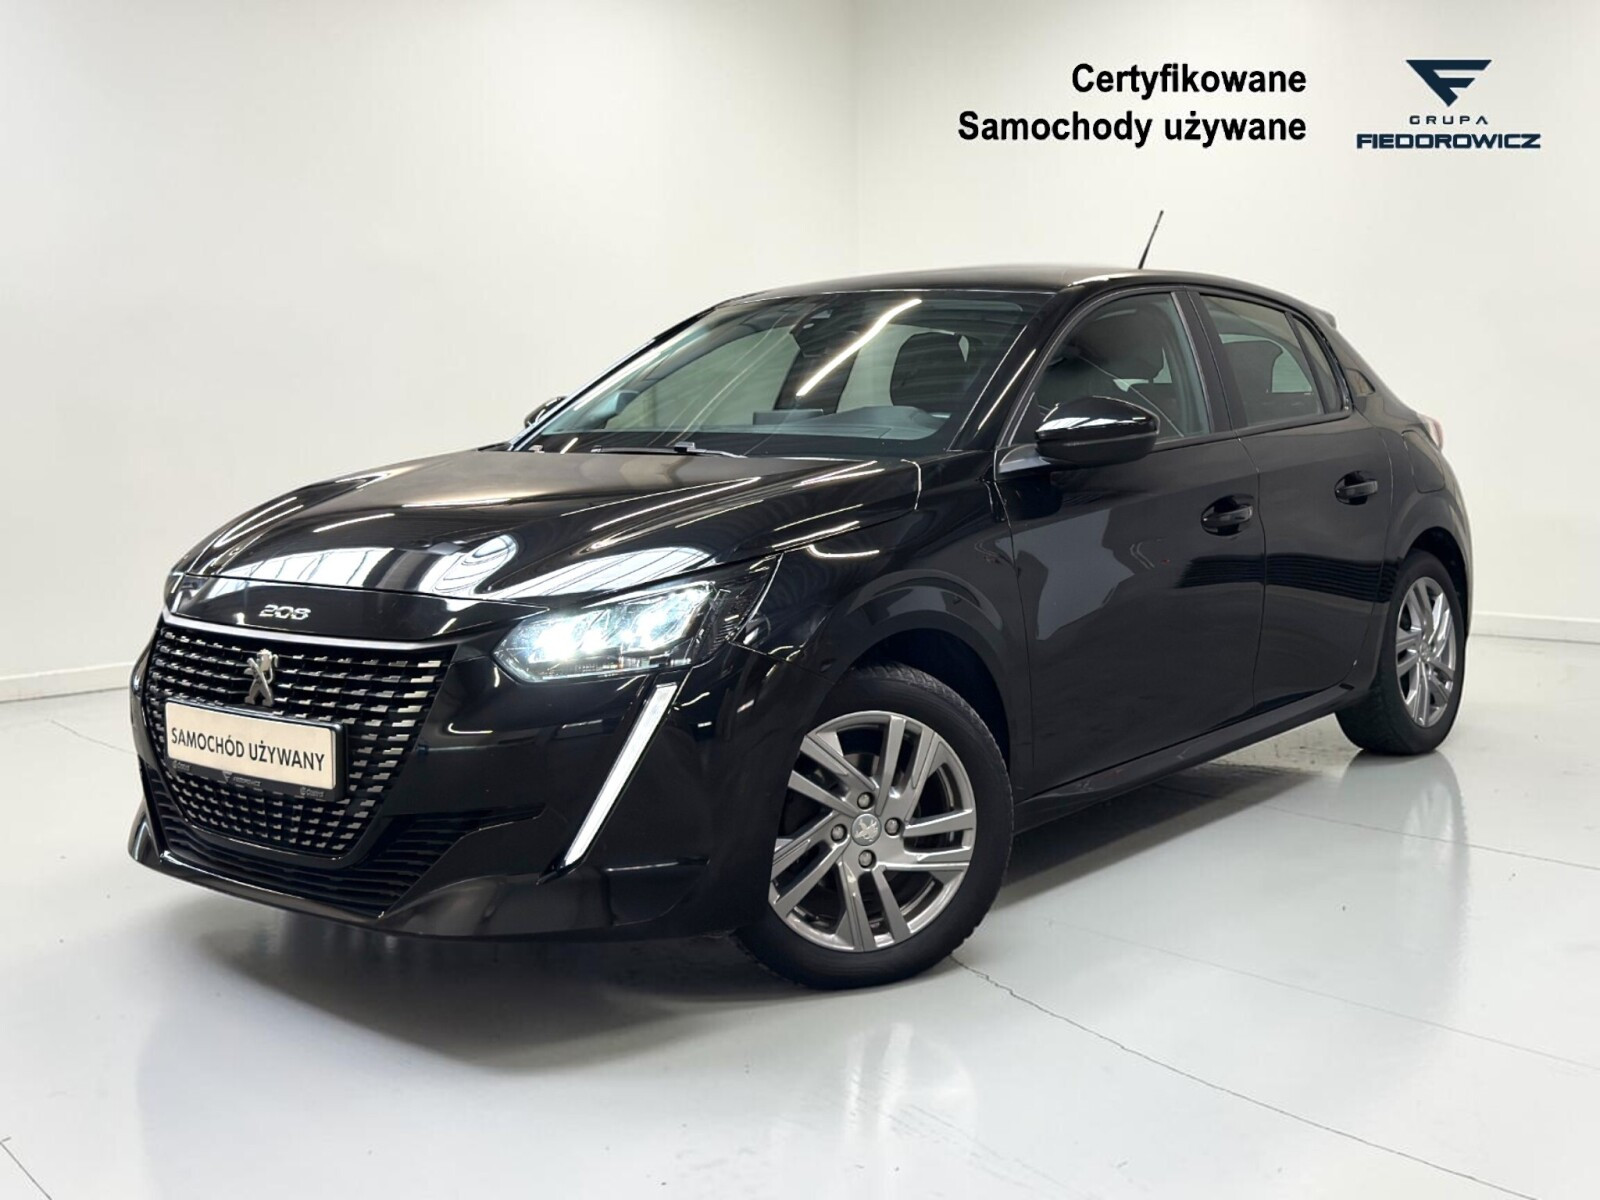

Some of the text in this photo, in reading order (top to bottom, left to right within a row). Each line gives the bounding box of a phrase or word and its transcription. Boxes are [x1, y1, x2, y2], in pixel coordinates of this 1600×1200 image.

[258, 604, 311, 621] 208
[170, 727, 325, 772] SAMOCHÓD UŻYWANY
